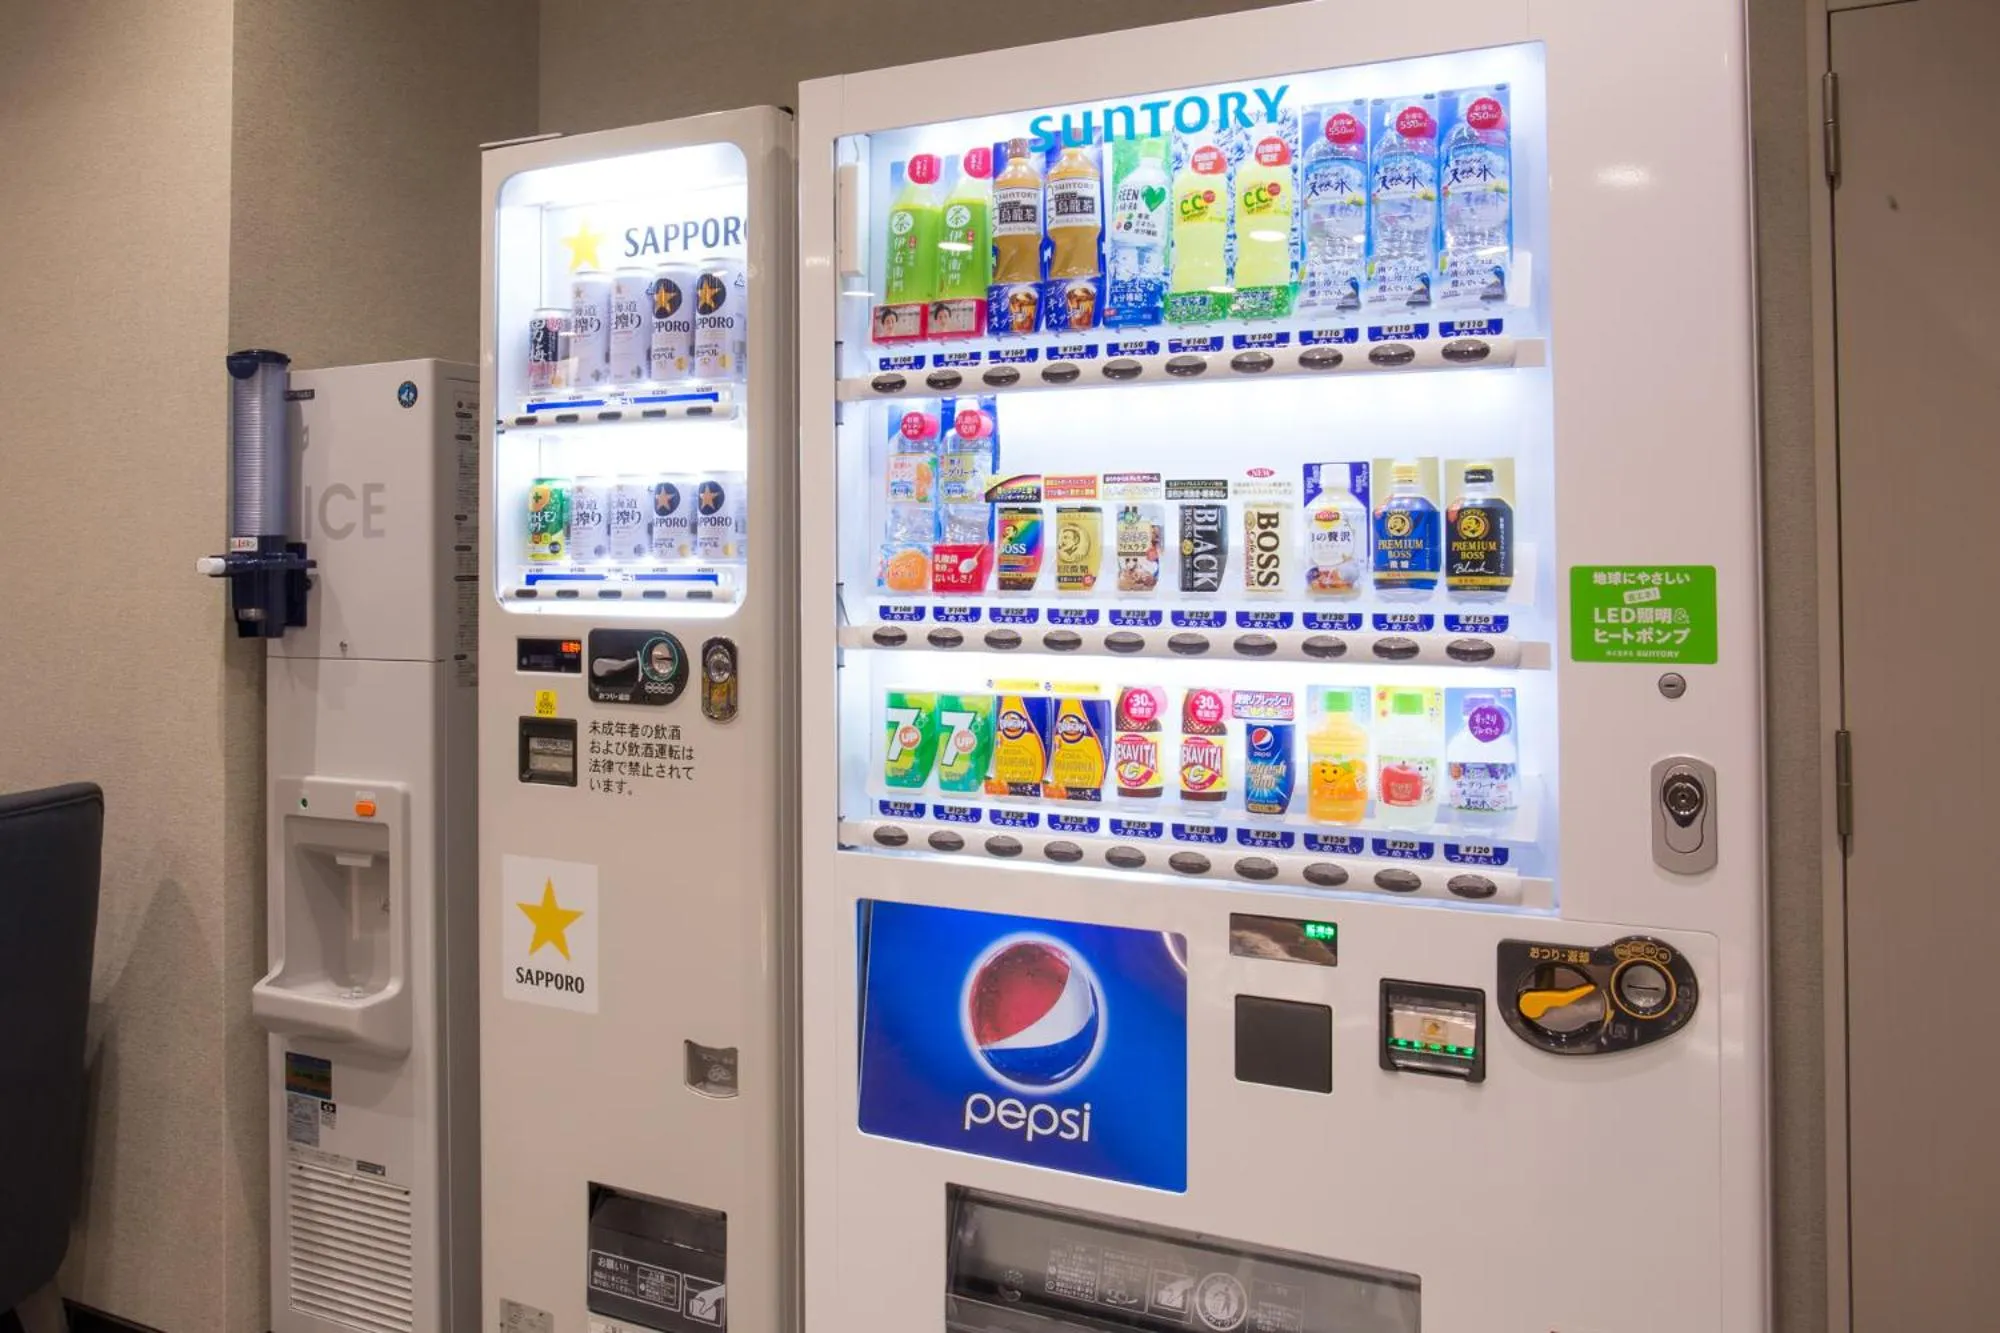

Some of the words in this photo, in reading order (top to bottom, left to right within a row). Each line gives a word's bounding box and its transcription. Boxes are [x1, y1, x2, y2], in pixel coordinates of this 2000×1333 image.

[1448, 164, 1496, 187] 天然水
[1309, 179, 1353, 198] 天然水
[1376, 173, 1425, 193] 天然水
[624, 215, 748, 258] SAPPOR
[304, 482, 386, 540] ICE
[1184, 508, 1193, 538] BOSS
[1193, 508, 1219, 588] BLACK
[1257, 511, 1280, 588] BOSS
[1377, 539, 1425, 550] PREMIUM
[1451, 541, 1498, 552] PREMIUM
[1388, 550, 1412, 559] BOSS
[1461, 551, 1485, 560] BOSS
[1593, 571, 1690, 586] 地球にやさしい
[884, 613, 921, 621] つめたい
[938, 615, 975, 623] つめたい
[995, 616, 1033, 624] つめたい
[1054, 617, 1094, 625] つめたい
[1115, 618, 1157, 626] つめたい
[1464, 616, 1490, 624] ¥150
[1177, 619, 1221, 627] つめたい
[1242, 620, 1287, 629] つめたい
[1310, 621, 1356, 630] つめたい
[1379, 623, 1428, 631] つめたい
[1452, 624, 1502, 632] つめたい
[1594, 627, 1691, 645] ヒートポンプ
[588, 721, 682, 741] 未成年者の飲酒
[589, 741, 694, 761] および飲酒運転は
[1116, 743, 1157, 770] EKAVITA
[1181, 745, 1222, 776] EKAVITA
[588, 759, 694, 780] 法律で禁止されて
[589, 779, 633, 796] います。
[885, 809, 921, 818] つめたい
[939, 813, 976, 823] つめたい
[995, 817, 1034, 828] つめたい
[1053, 822, 1095, 832] つめたい
[1115, 828, 1157, 838] つめたい
[1178, 833, 1222, 843] つめたい
[1243, 838, 1288, 848] つめたい
[1311, 843, 1358, 854] つめたい
[1379, 849, 1428, 859] つめたい
[1451, 854, 1502, 865] つめたい
[515, 966, 585, 994] SAPPORO
[964, 1092, 1092, 1142] pepsi
